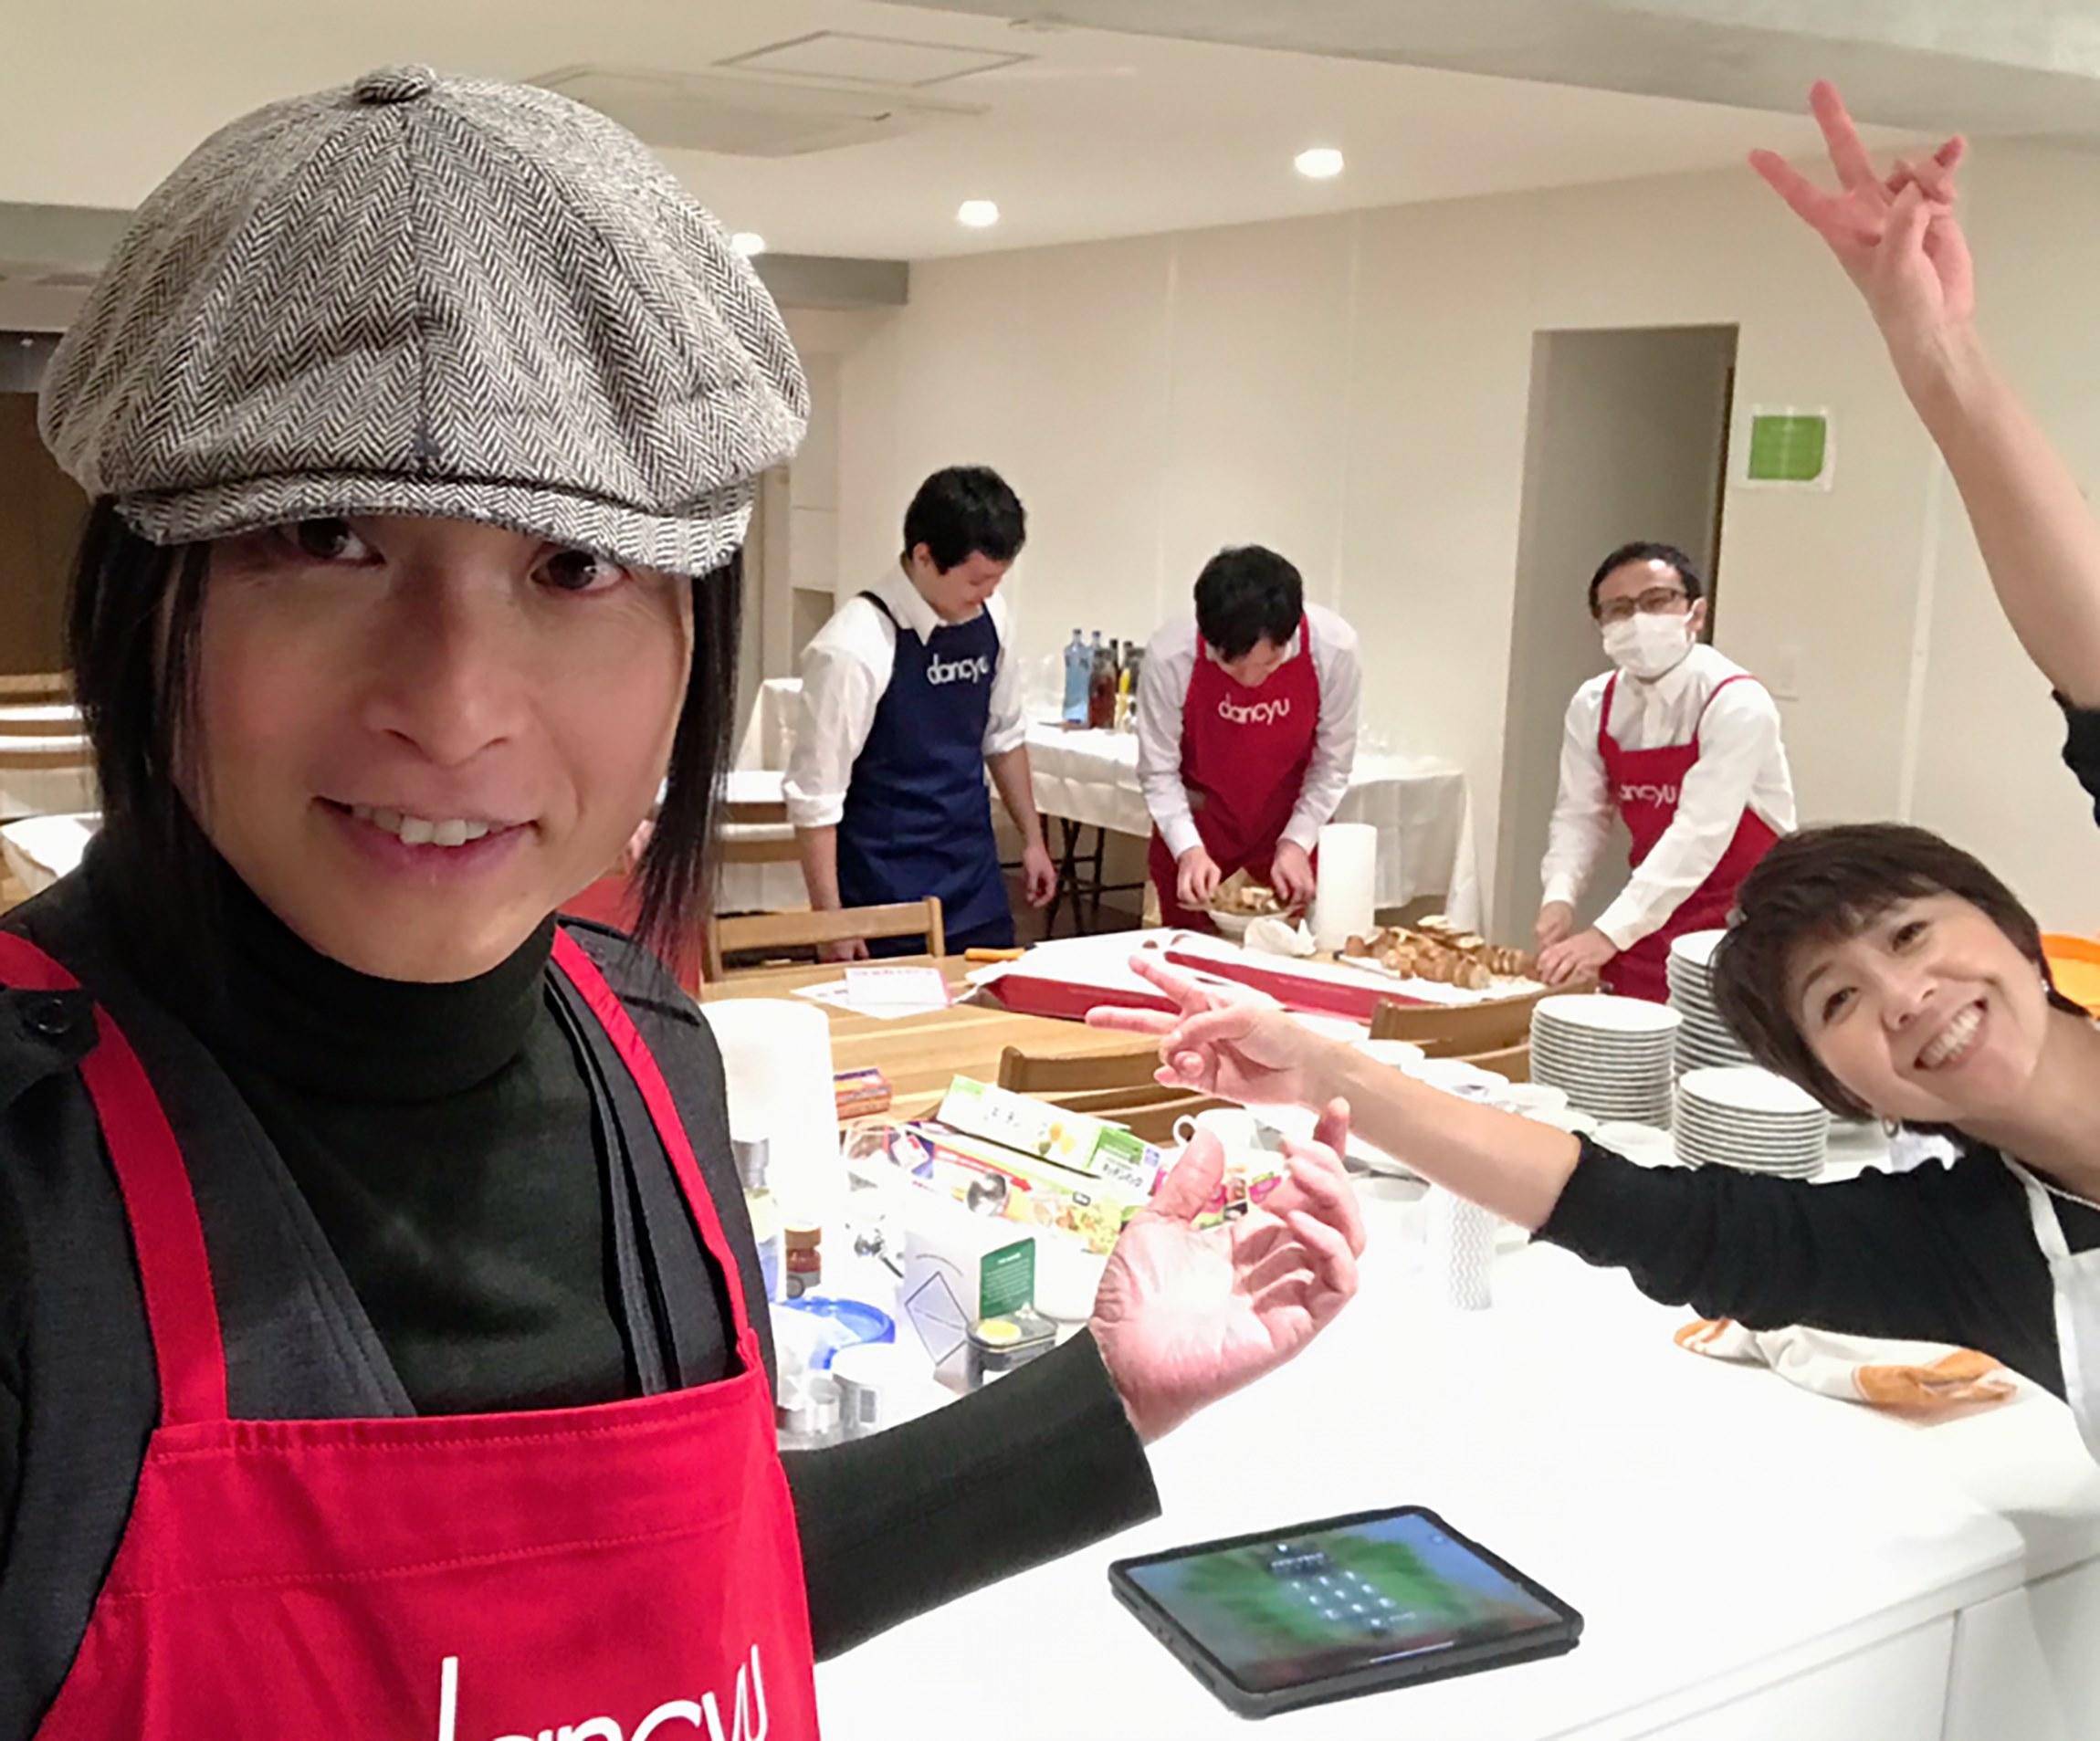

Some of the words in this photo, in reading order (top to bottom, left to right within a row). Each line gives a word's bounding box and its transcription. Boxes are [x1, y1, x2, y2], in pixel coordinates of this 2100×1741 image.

[927, 653, 989, 685] dancyu
[1218, 691, 1290, 726] dancyu
[1619, 784, 1676, 809] ancyu
